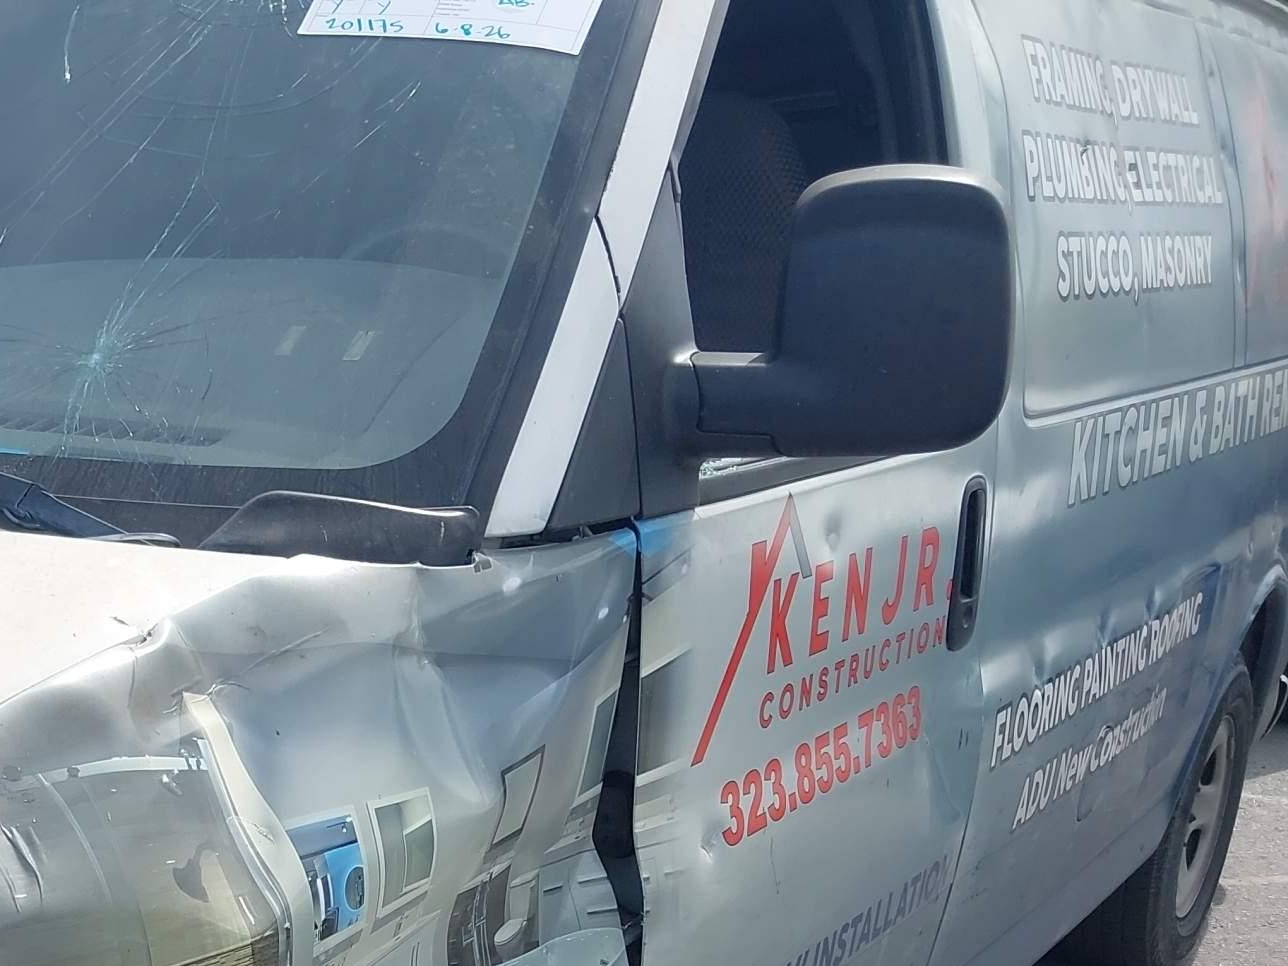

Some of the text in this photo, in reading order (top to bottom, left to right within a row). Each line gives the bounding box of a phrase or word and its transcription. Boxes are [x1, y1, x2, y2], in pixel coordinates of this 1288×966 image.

[1021, 35, 1200, 128] FRAMING, DRYWALL
[1123, 149, 1224, 205] ELECTRICAL
[1057, 232, 1213, 305] STUCCO, MASONRY
[1067, 392, 1189, 508] KITCHEN
[1189, 388, 1209, 463] &
[1209, 375, 1261, 456] BATH
[760, 614, 947, 729] CONSTRUCTION
[767, 547, 873, 675] KEN
[990, 592, 1204, 770] FLOORING PAINTING ROOFING
[720, 685, 923, 847] 323.855.7363
[1012, 682, 1168, 832] ADU New Construction
